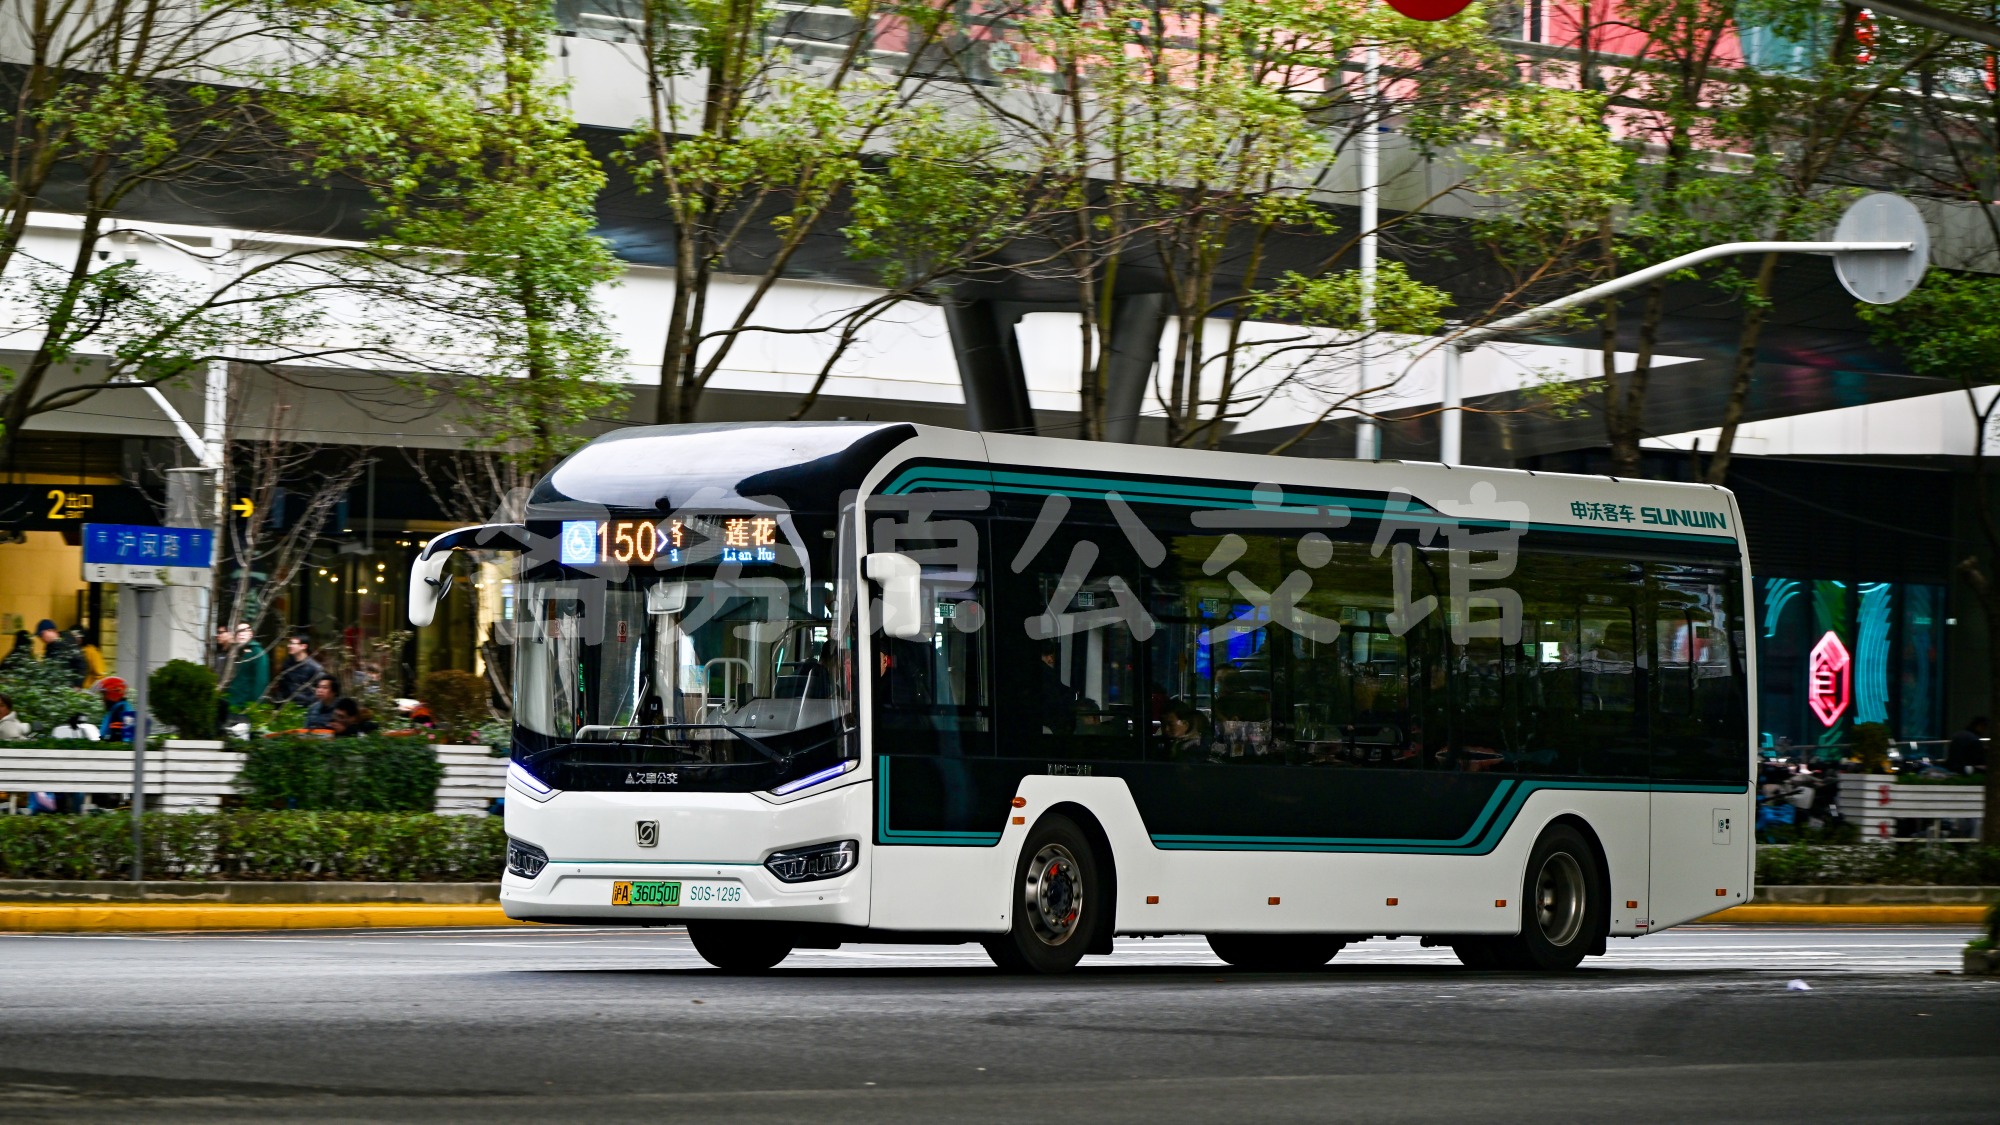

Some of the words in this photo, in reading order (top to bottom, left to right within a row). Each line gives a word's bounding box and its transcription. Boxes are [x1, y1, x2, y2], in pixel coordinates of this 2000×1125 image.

[48, 489, 65, 519] 2
[65, 493, 94, 508] 出口
[1570, 501, 1636, 523] 申沃客车
[1640, 506, 1727, 529] SUNWIN
[597, 521, 656, 562] 150
[725, 518, 776, 547] 莲花
[723, 547, 753, 562] Lian
[757, 547, 776, 561] Hu
